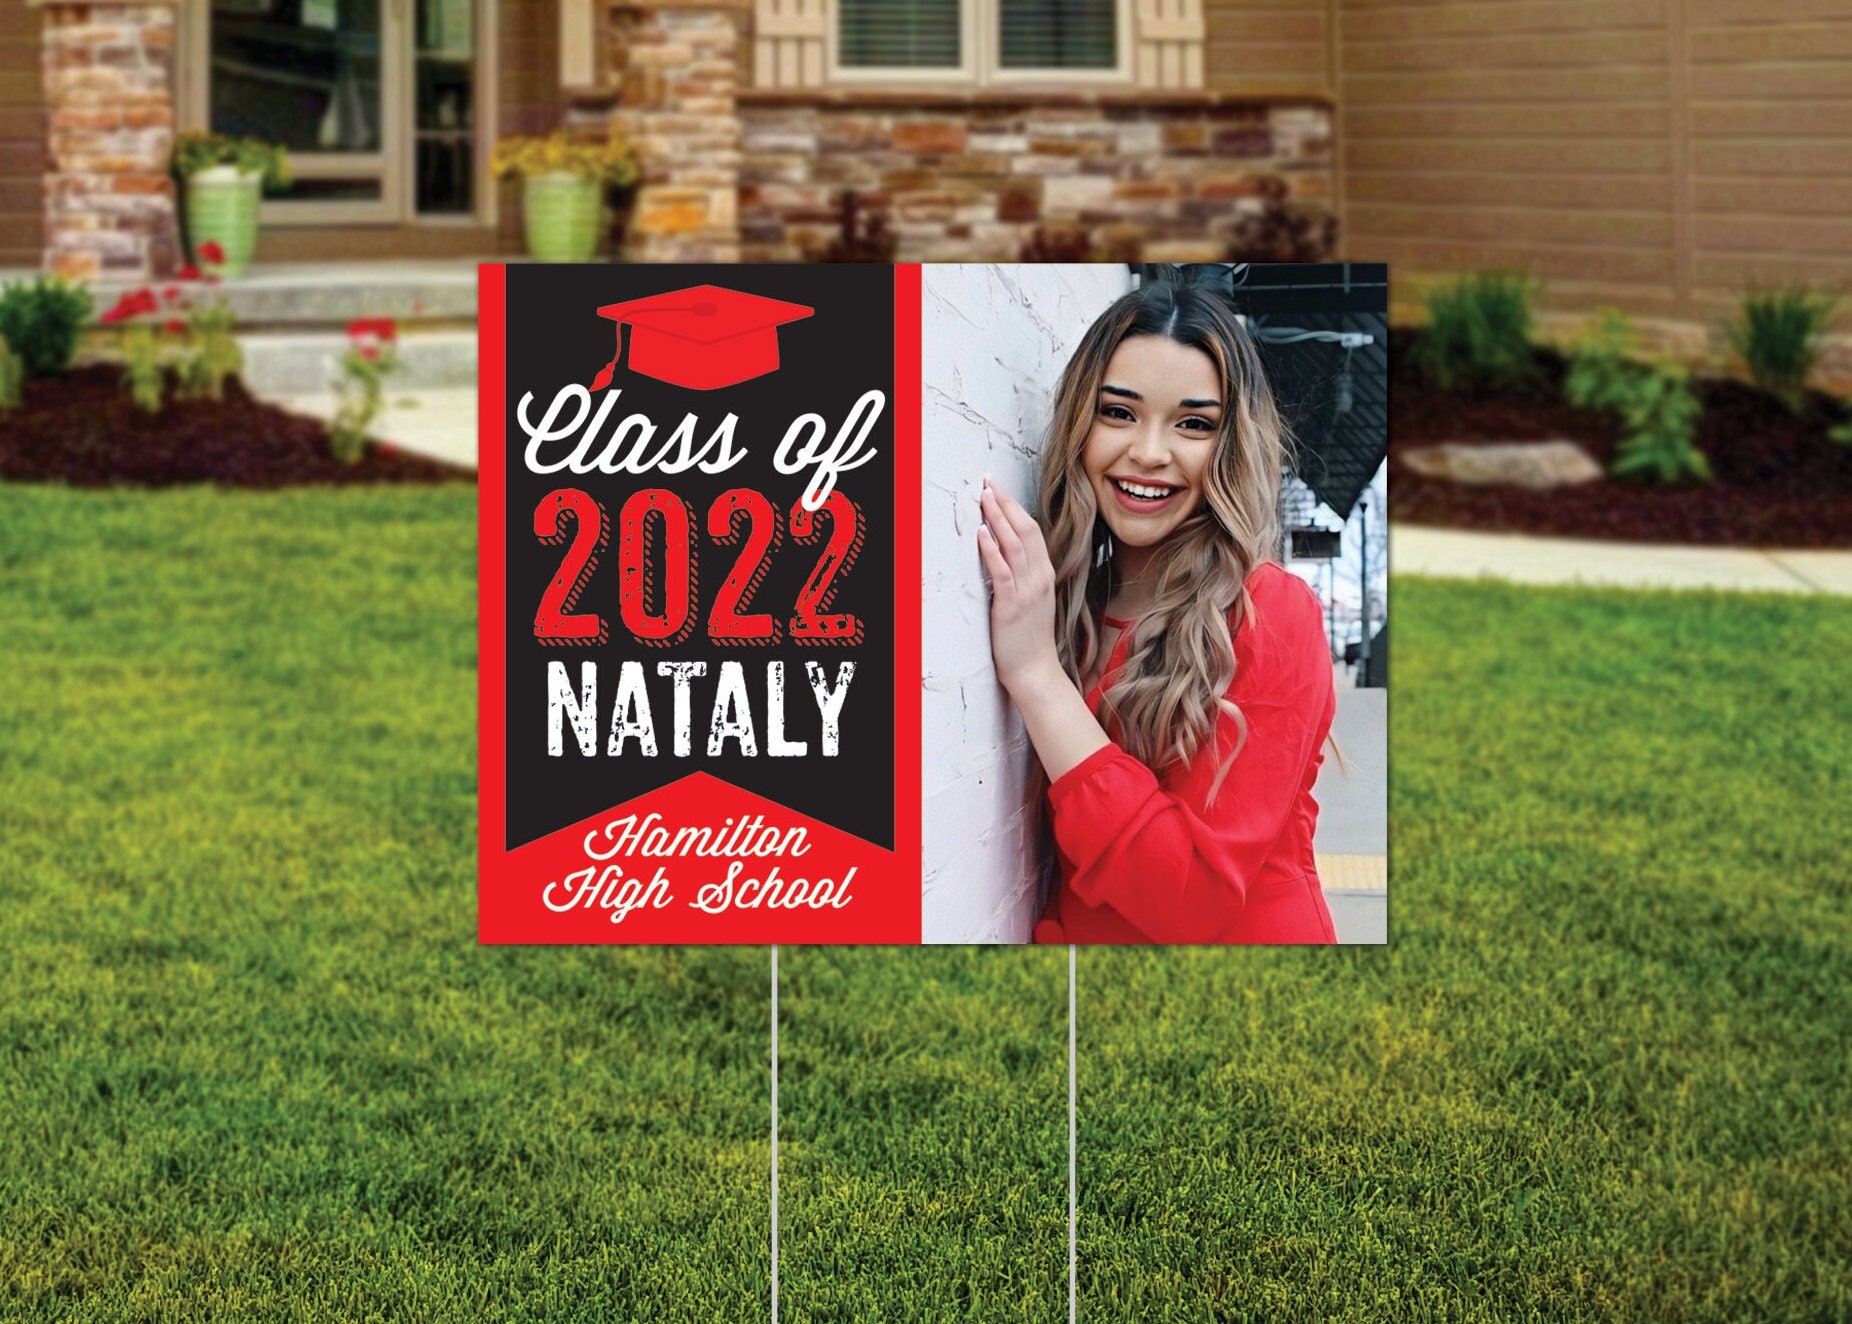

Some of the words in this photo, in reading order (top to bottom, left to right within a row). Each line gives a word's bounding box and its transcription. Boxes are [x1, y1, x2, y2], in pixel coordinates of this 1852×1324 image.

[517, 383, 749, 474] Class
[772, 389, 886, 511] of
[533, 488, 866, 648] 2022
[547, 661, 857, 757] NATALY
[583, 812, 811, 860] Hamilton
[542, 864, 674, 924] High
[689, 860, 858, 914] School
